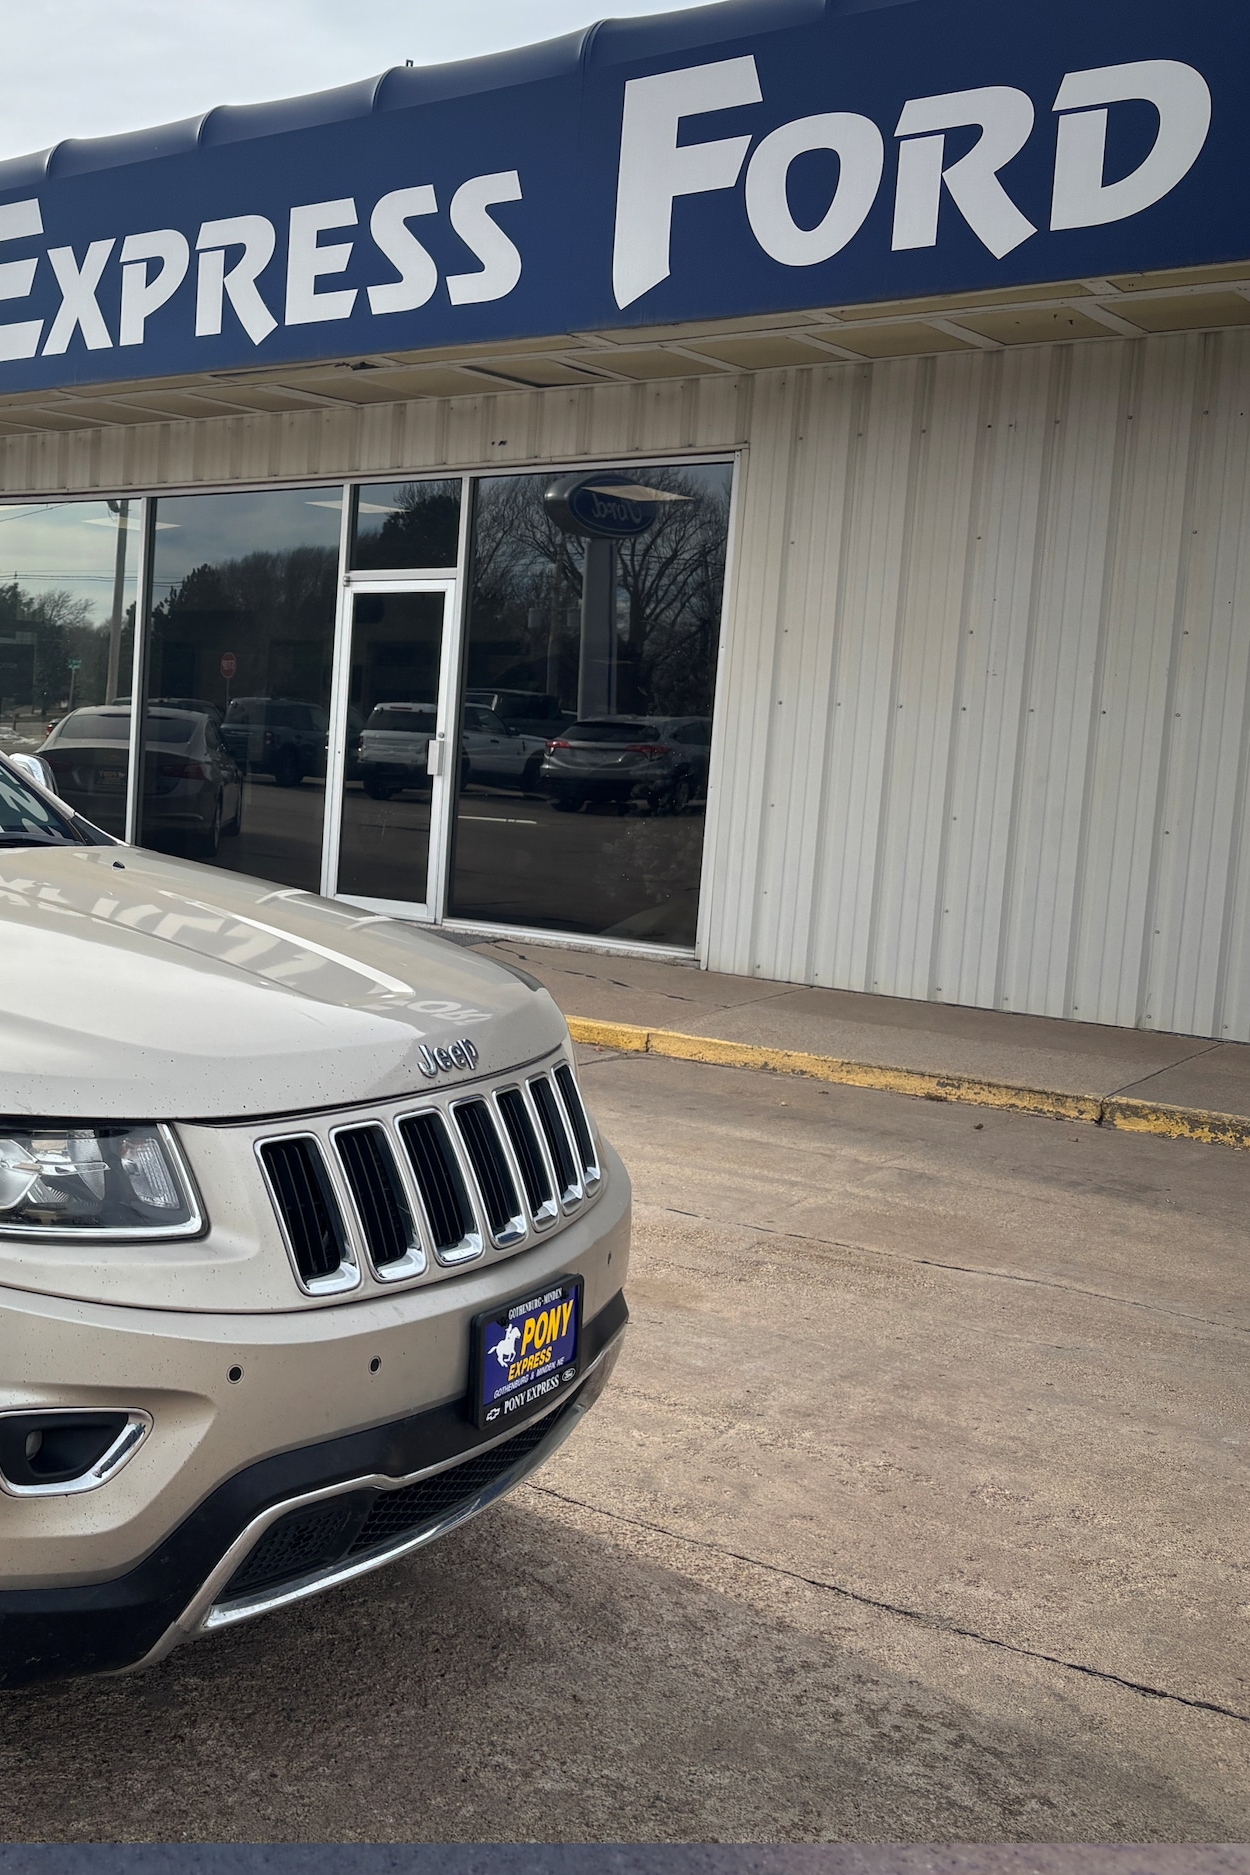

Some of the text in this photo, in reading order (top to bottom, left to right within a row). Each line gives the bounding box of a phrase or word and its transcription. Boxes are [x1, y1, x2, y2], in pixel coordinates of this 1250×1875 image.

[612, 54, 1212, 310] FORD
[417, 1039, 479, 1078] Jeep
[520, 1299, 575, 1356] PONY
[493, 1374, 530, 1399] GOTHENBURG
[556, 1356, 565, 1368] NE
[508, 1346, 553, 1382] EXPRESS
[504, 1391, 527, 1415] PONY
[526, 1374, 560, 1403] EXPRESS
